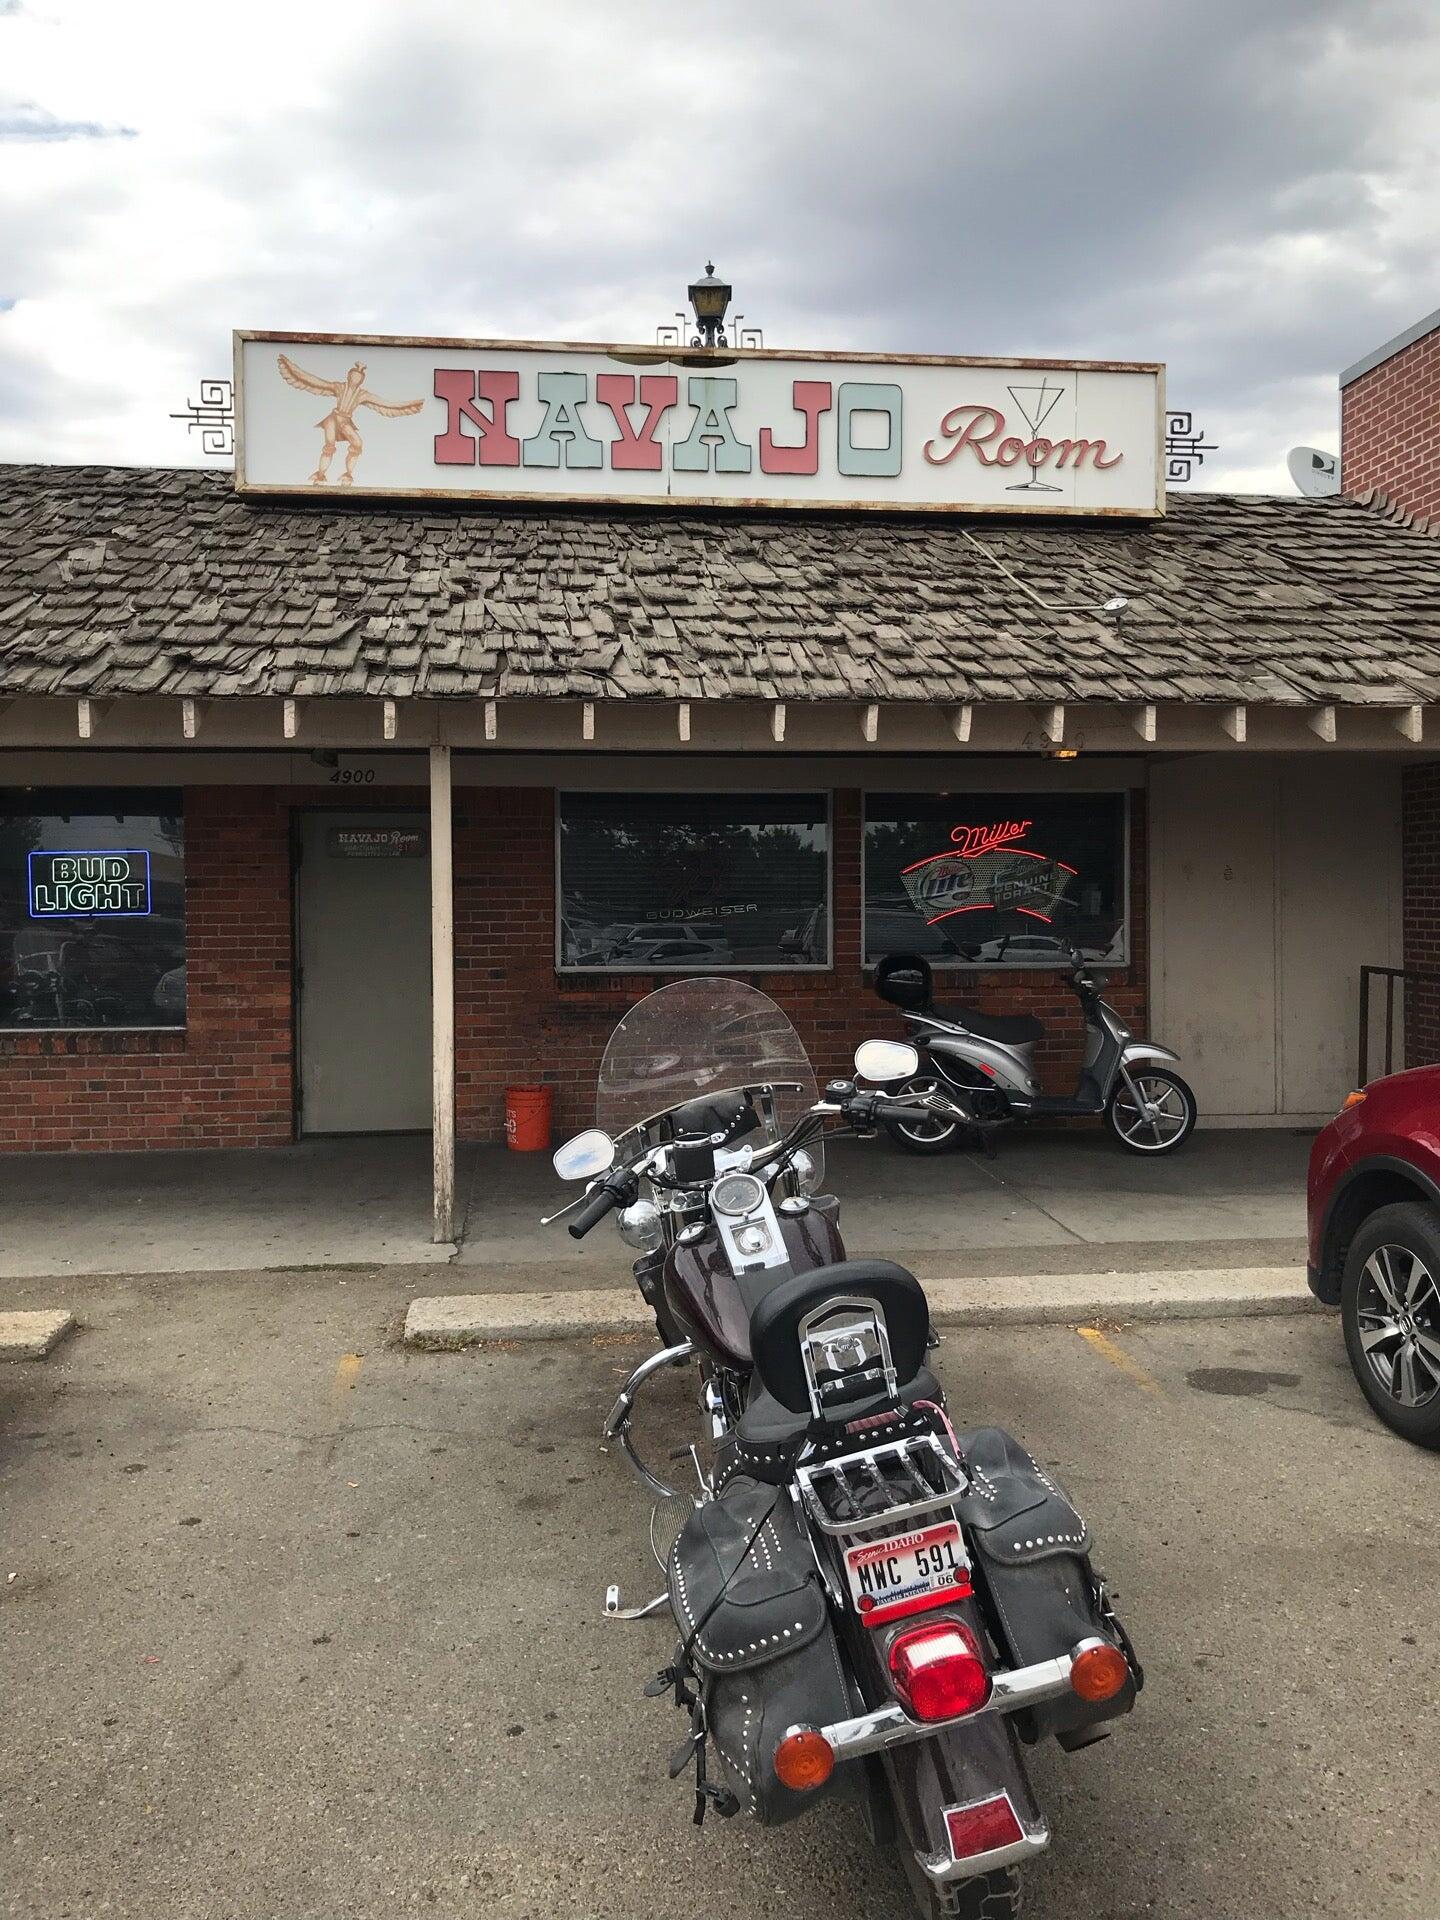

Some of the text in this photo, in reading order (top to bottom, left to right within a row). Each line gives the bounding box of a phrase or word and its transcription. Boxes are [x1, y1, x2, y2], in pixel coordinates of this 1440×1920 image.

[433, 368, 1124, 478] NAVAJO Room
[329, 769, 375, 784] 4900
[338, 831, 419, 845] NAVAJO Room
[951, 820, 1032, 852] Miller
[52, 857, 130, 883] BUD
[35, 883, 145, 911] LIGHT
[1003, 882, 1049, 901] DRAFT
[646, 903, 758, 920] BUDWEISER
[857, 1533, 924, 1563] Scenic IDAHO
[857, 1540, 958, 1594] MWC 591
[938, 1574, 953, 1586] 06
